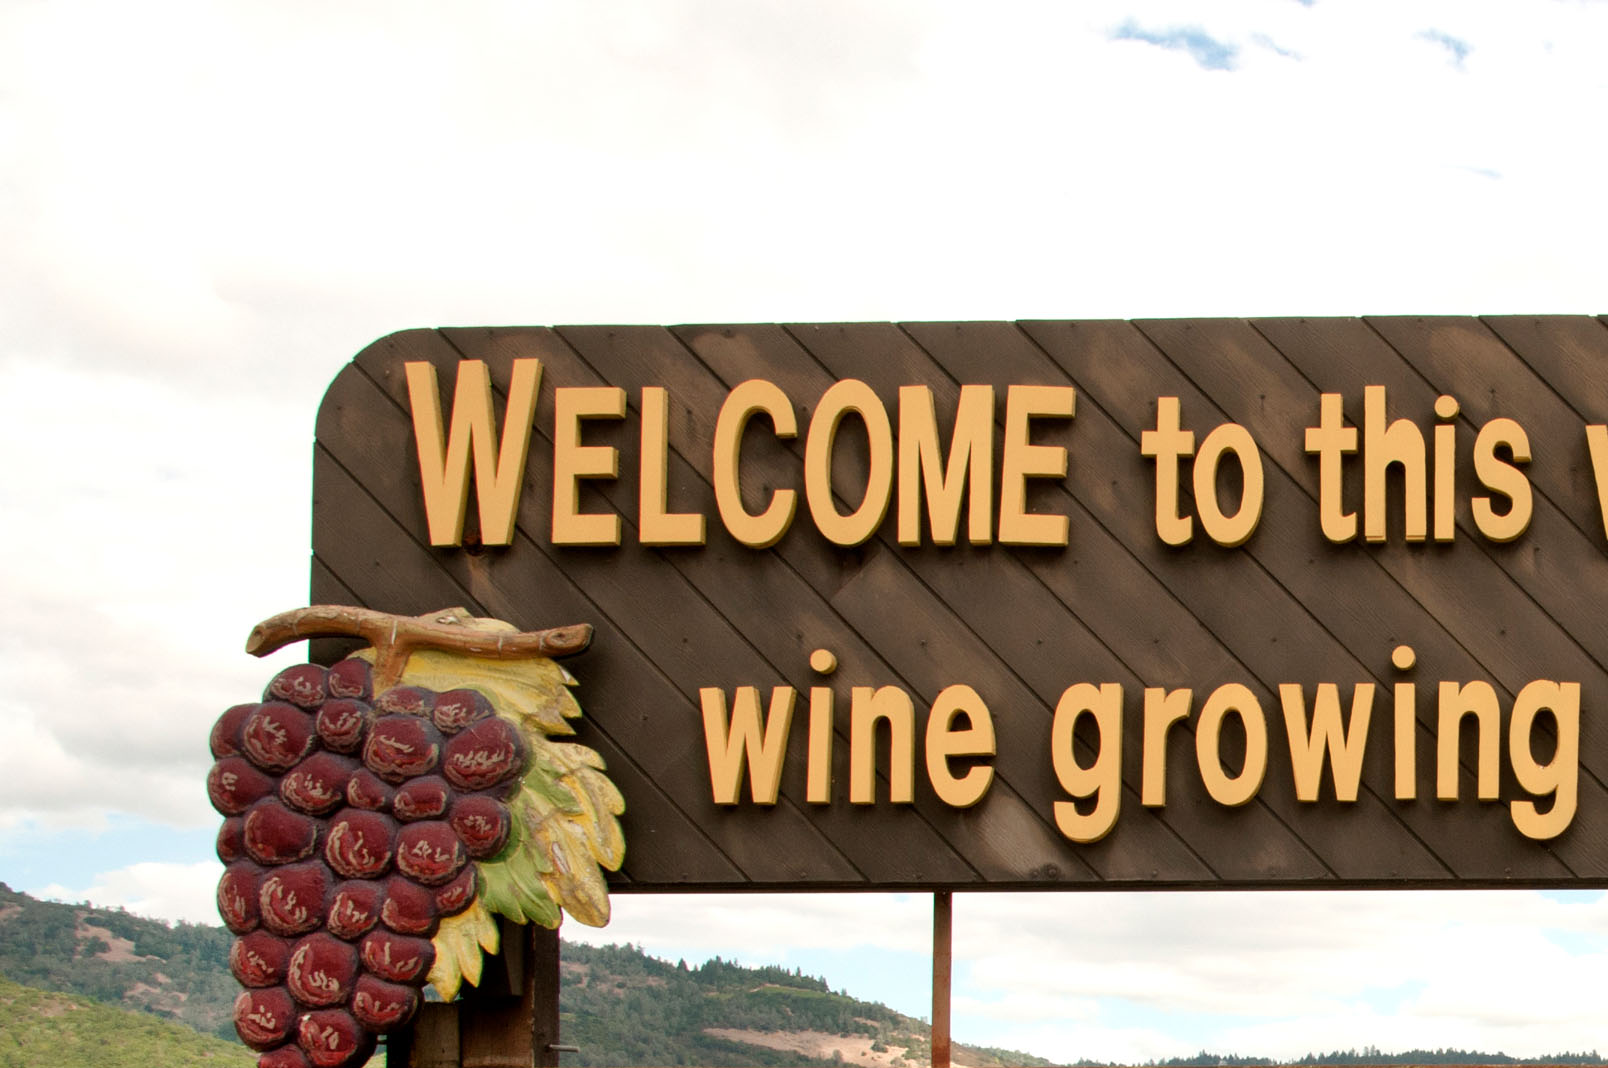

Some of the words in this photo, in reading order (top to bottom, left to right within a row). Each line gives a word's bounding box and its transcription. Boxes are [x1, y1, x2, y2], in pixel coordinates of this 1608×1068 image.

[404, 357, 1076, 548] WELCOME
[1140, 396, 1264, 547] to
[1304, 385, 1533, 544] this
[699, 648, 997, 808] wine
[1051, 645, 1581, 842] growing
